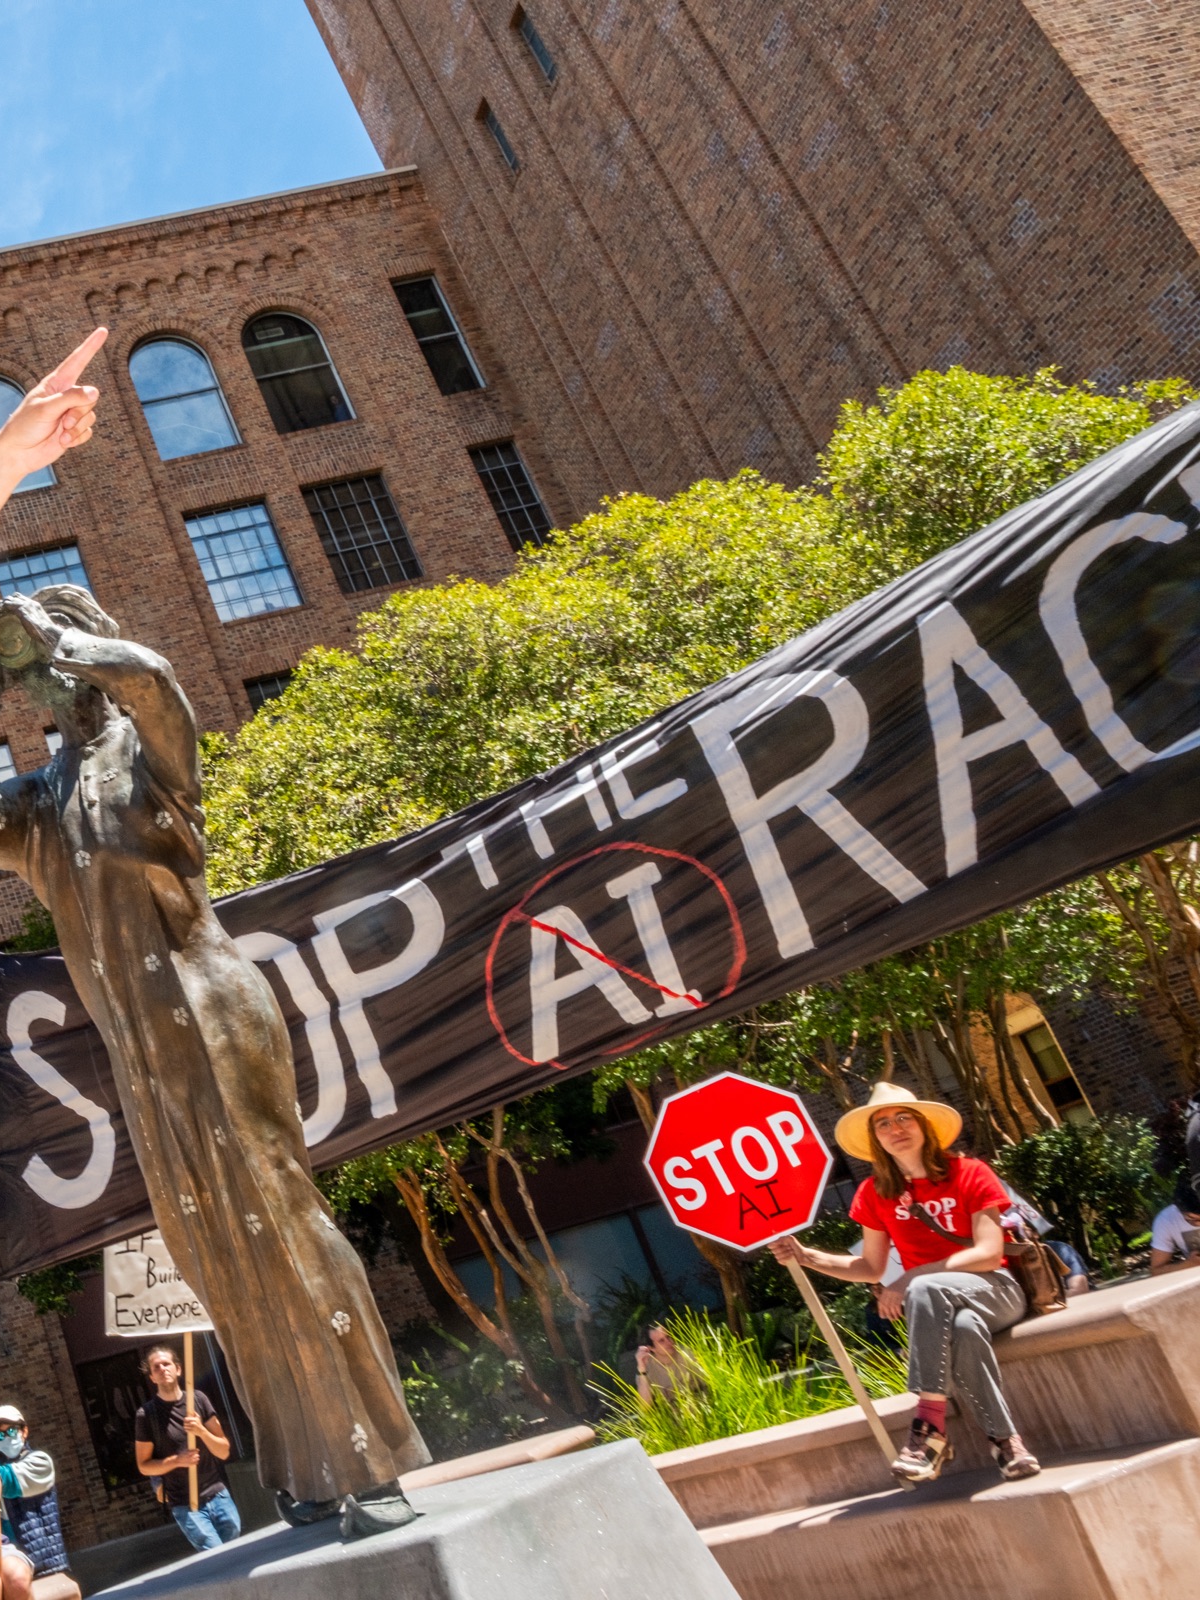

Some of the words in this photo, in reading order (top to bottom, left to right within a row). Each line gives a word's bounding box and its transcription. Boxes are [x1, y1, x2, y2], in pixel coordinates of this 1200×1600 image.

[530, 861, 703, 1063] AI
[688, 460, 1200, 959] RAC
[663, 1110, 805, 1212] STOP
[739, 1179, 793, 1231] AI
[894, 1197, 958, 1221] SOP
[114, 1292, 202, 1330] Everyone
